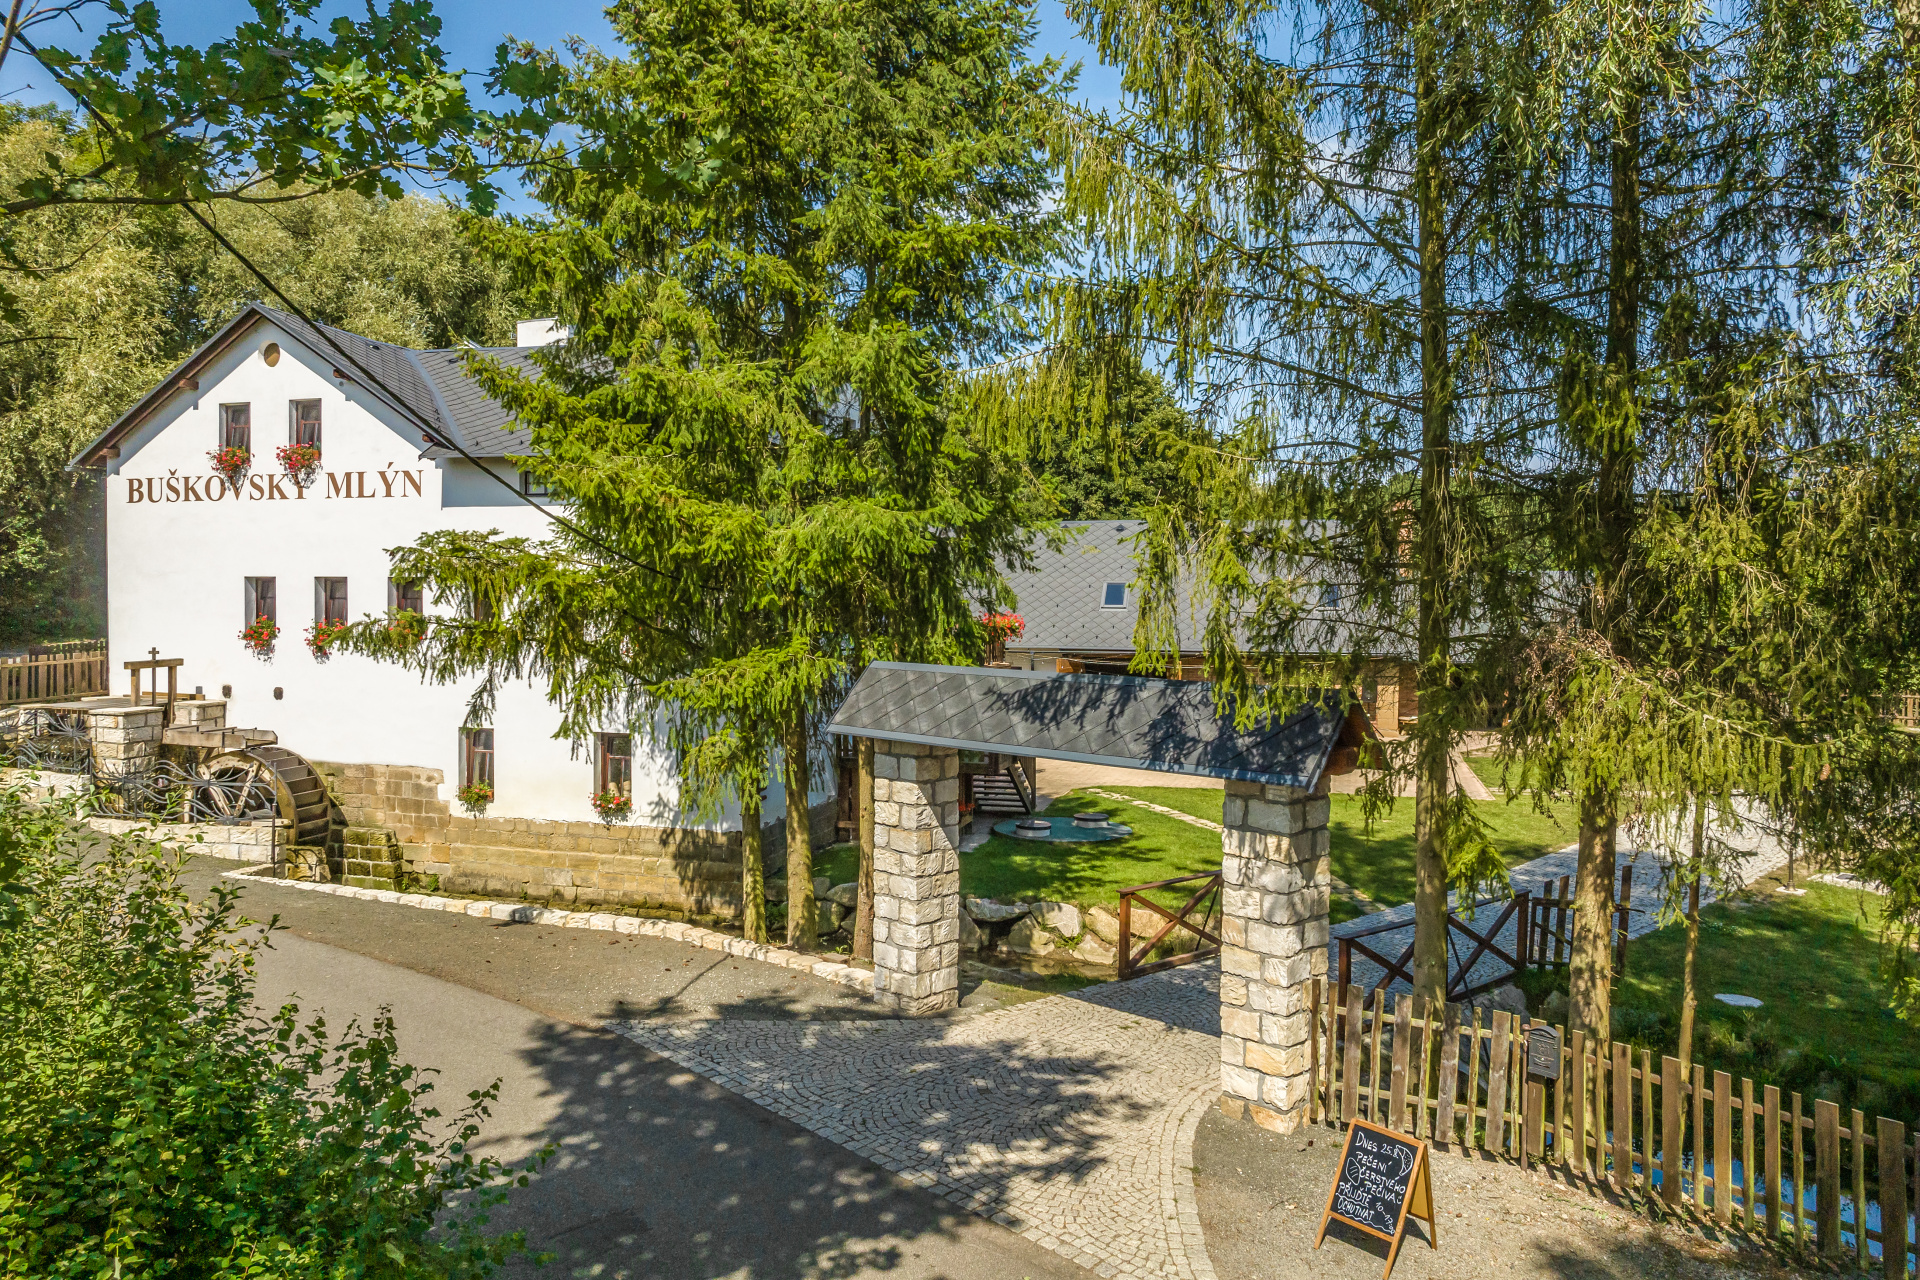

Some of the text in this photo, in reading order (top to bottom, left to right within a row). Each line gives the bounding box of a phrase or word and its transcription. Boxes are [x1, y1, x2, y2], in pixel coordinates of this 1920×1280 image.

[325, 461, 424, 499] MLÝN
[1355, 1131, 1378, 1152] DNES
[1355, 1151, 1392, 1173] PEČENÍ
[1359, 1166, 1406, 1194] ČERSTVÉHO
[1338, 1181, 1372, 1206] PŘIJĎTE
[1337, 1197, 1375, 1221] OCHUTNAT
